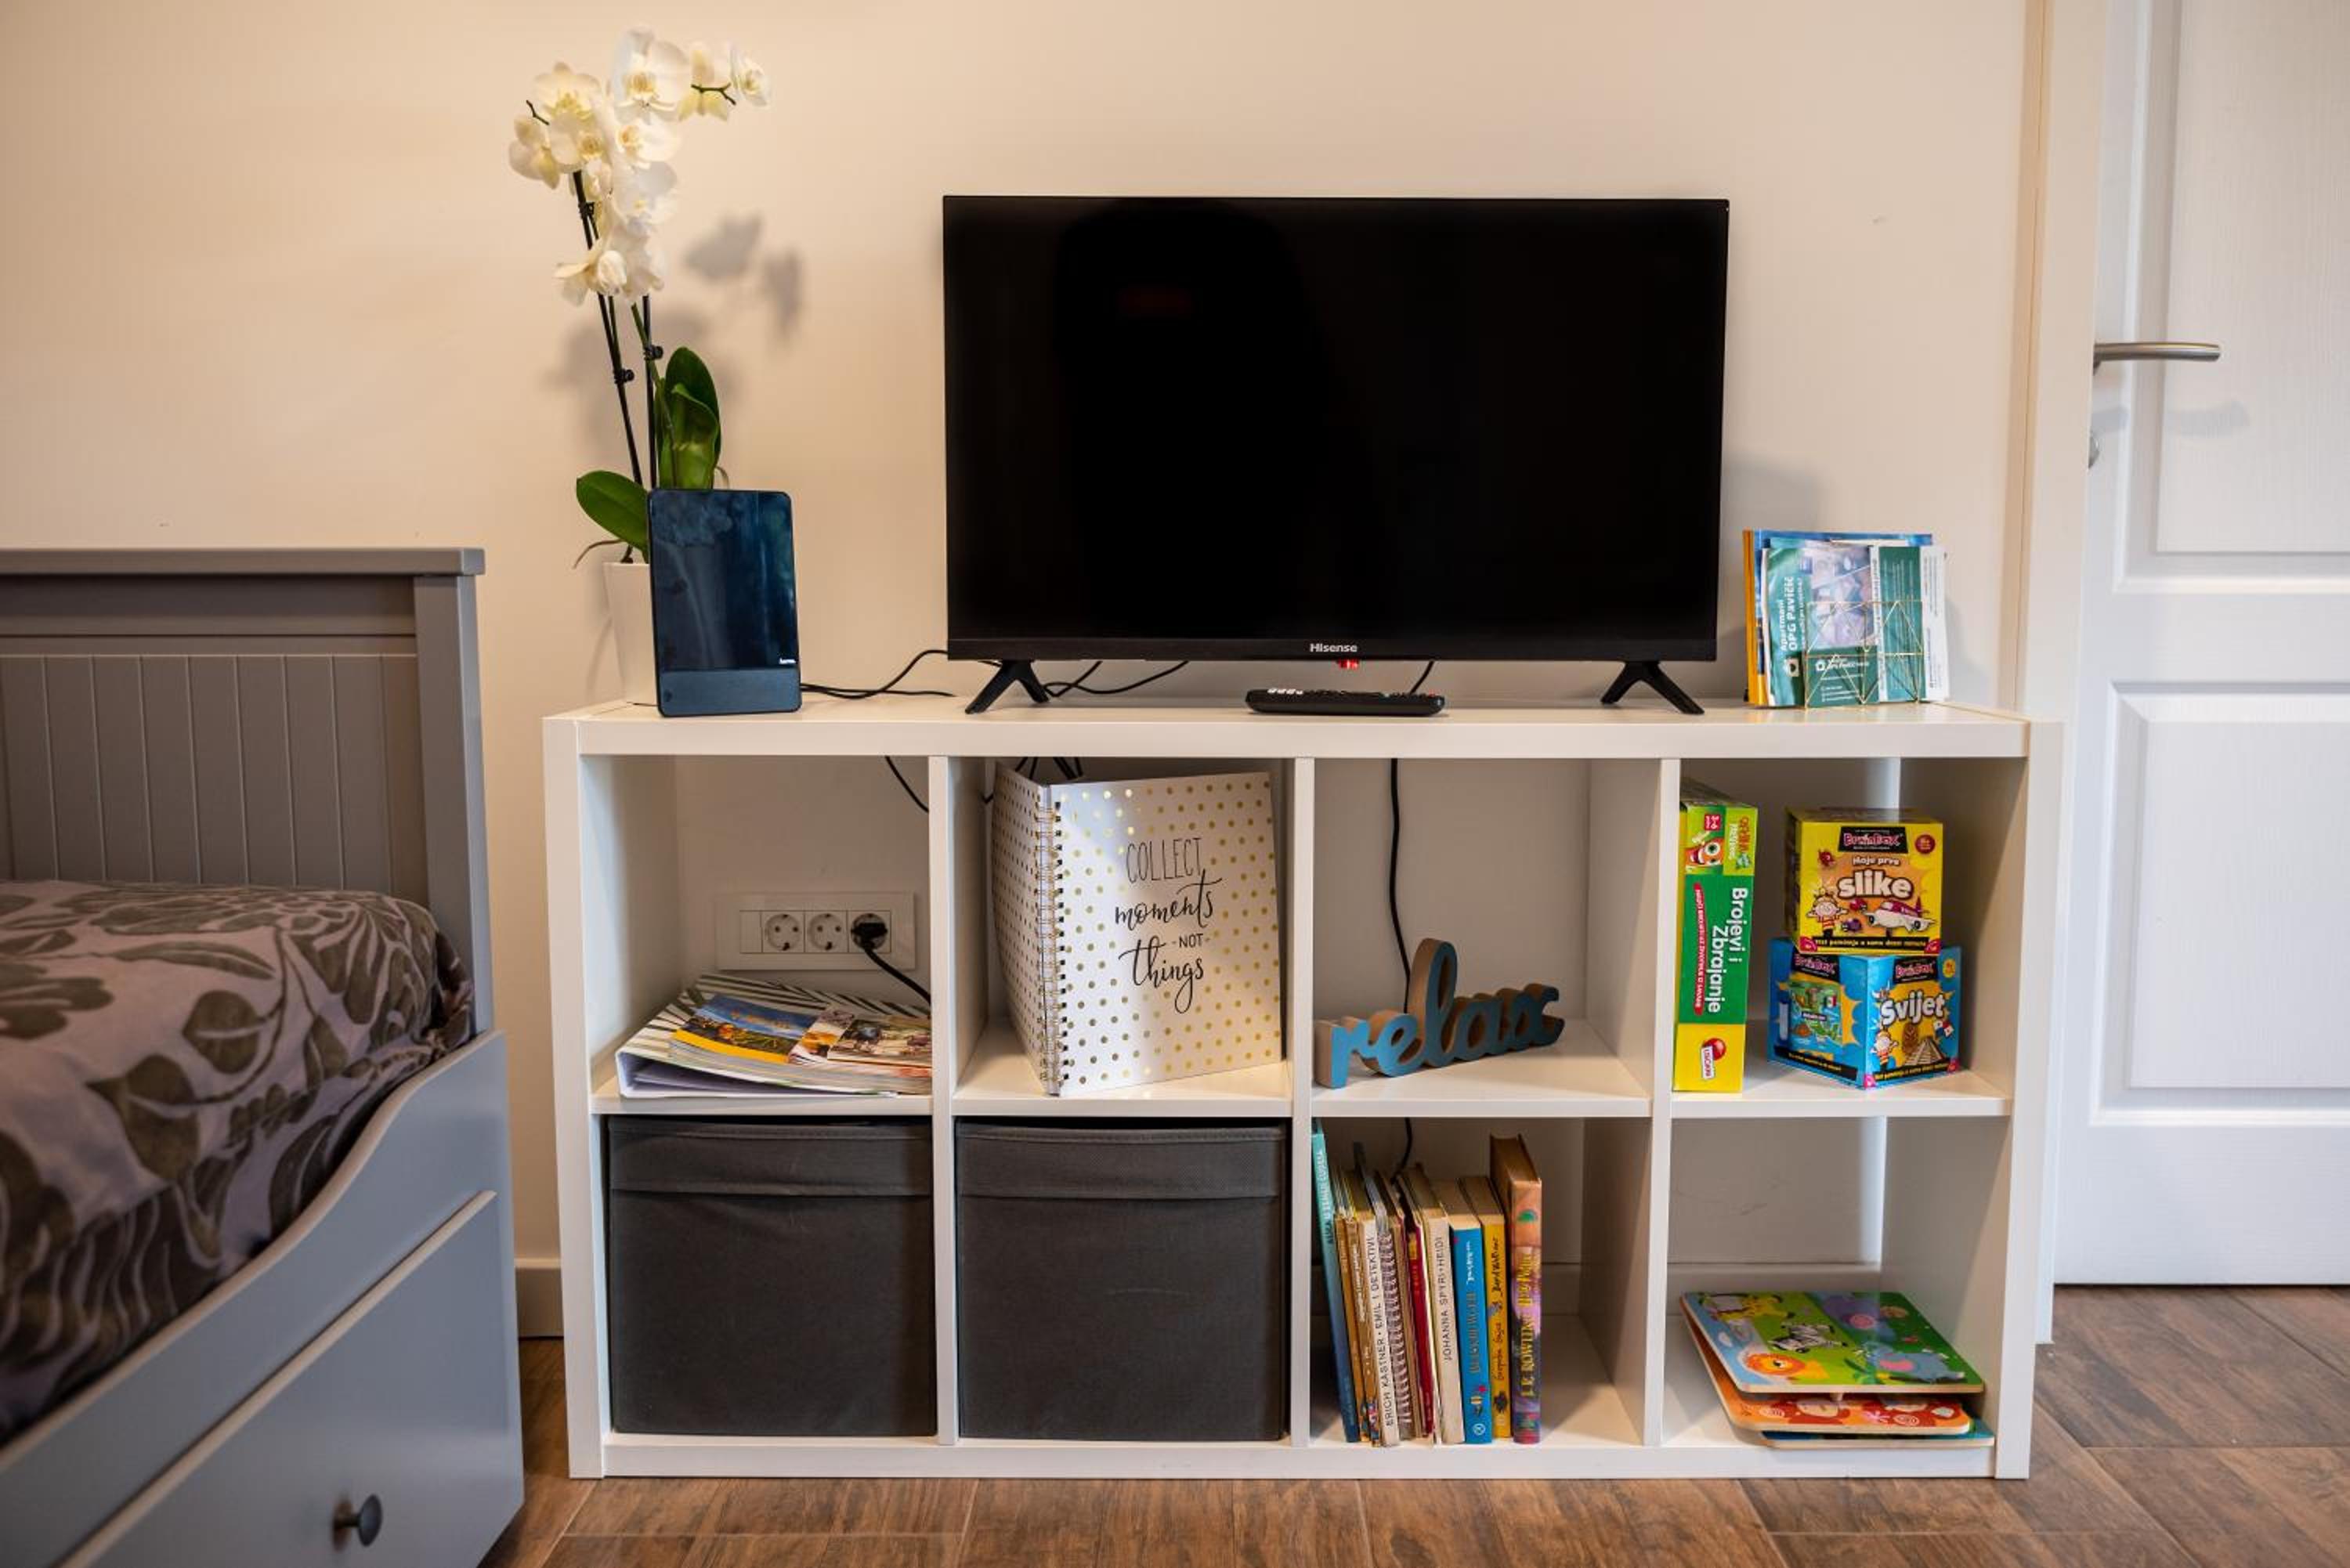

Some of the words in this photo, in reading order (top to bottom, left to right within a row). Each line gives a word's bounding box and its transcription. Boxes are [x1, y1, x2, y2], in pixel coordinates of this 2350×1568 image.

[1310, 643, 1358, 652] Hisense
[1787, 623, 1798, 651] OPG
[1126, 838, 1202, 883] COLLECT
[1838, 868, 1913, 898] slike
[1115, 869, 1223, 930] moments
[1726, 887, 1748, 952] Brojevi
[1118, 935, 1204, 1013] things
[1705, 925, 1730, 1013] Zbrajanje
[1320, 939, 1565, 1089] relax
[1881, 990, 1945, 1026] Svijet
[1373, 1302, 1383, 1329] EMIL
[1441, 1309, 1452, 1360] JOHANNA
[1383, 1389, 1394, 1427] ERICH
